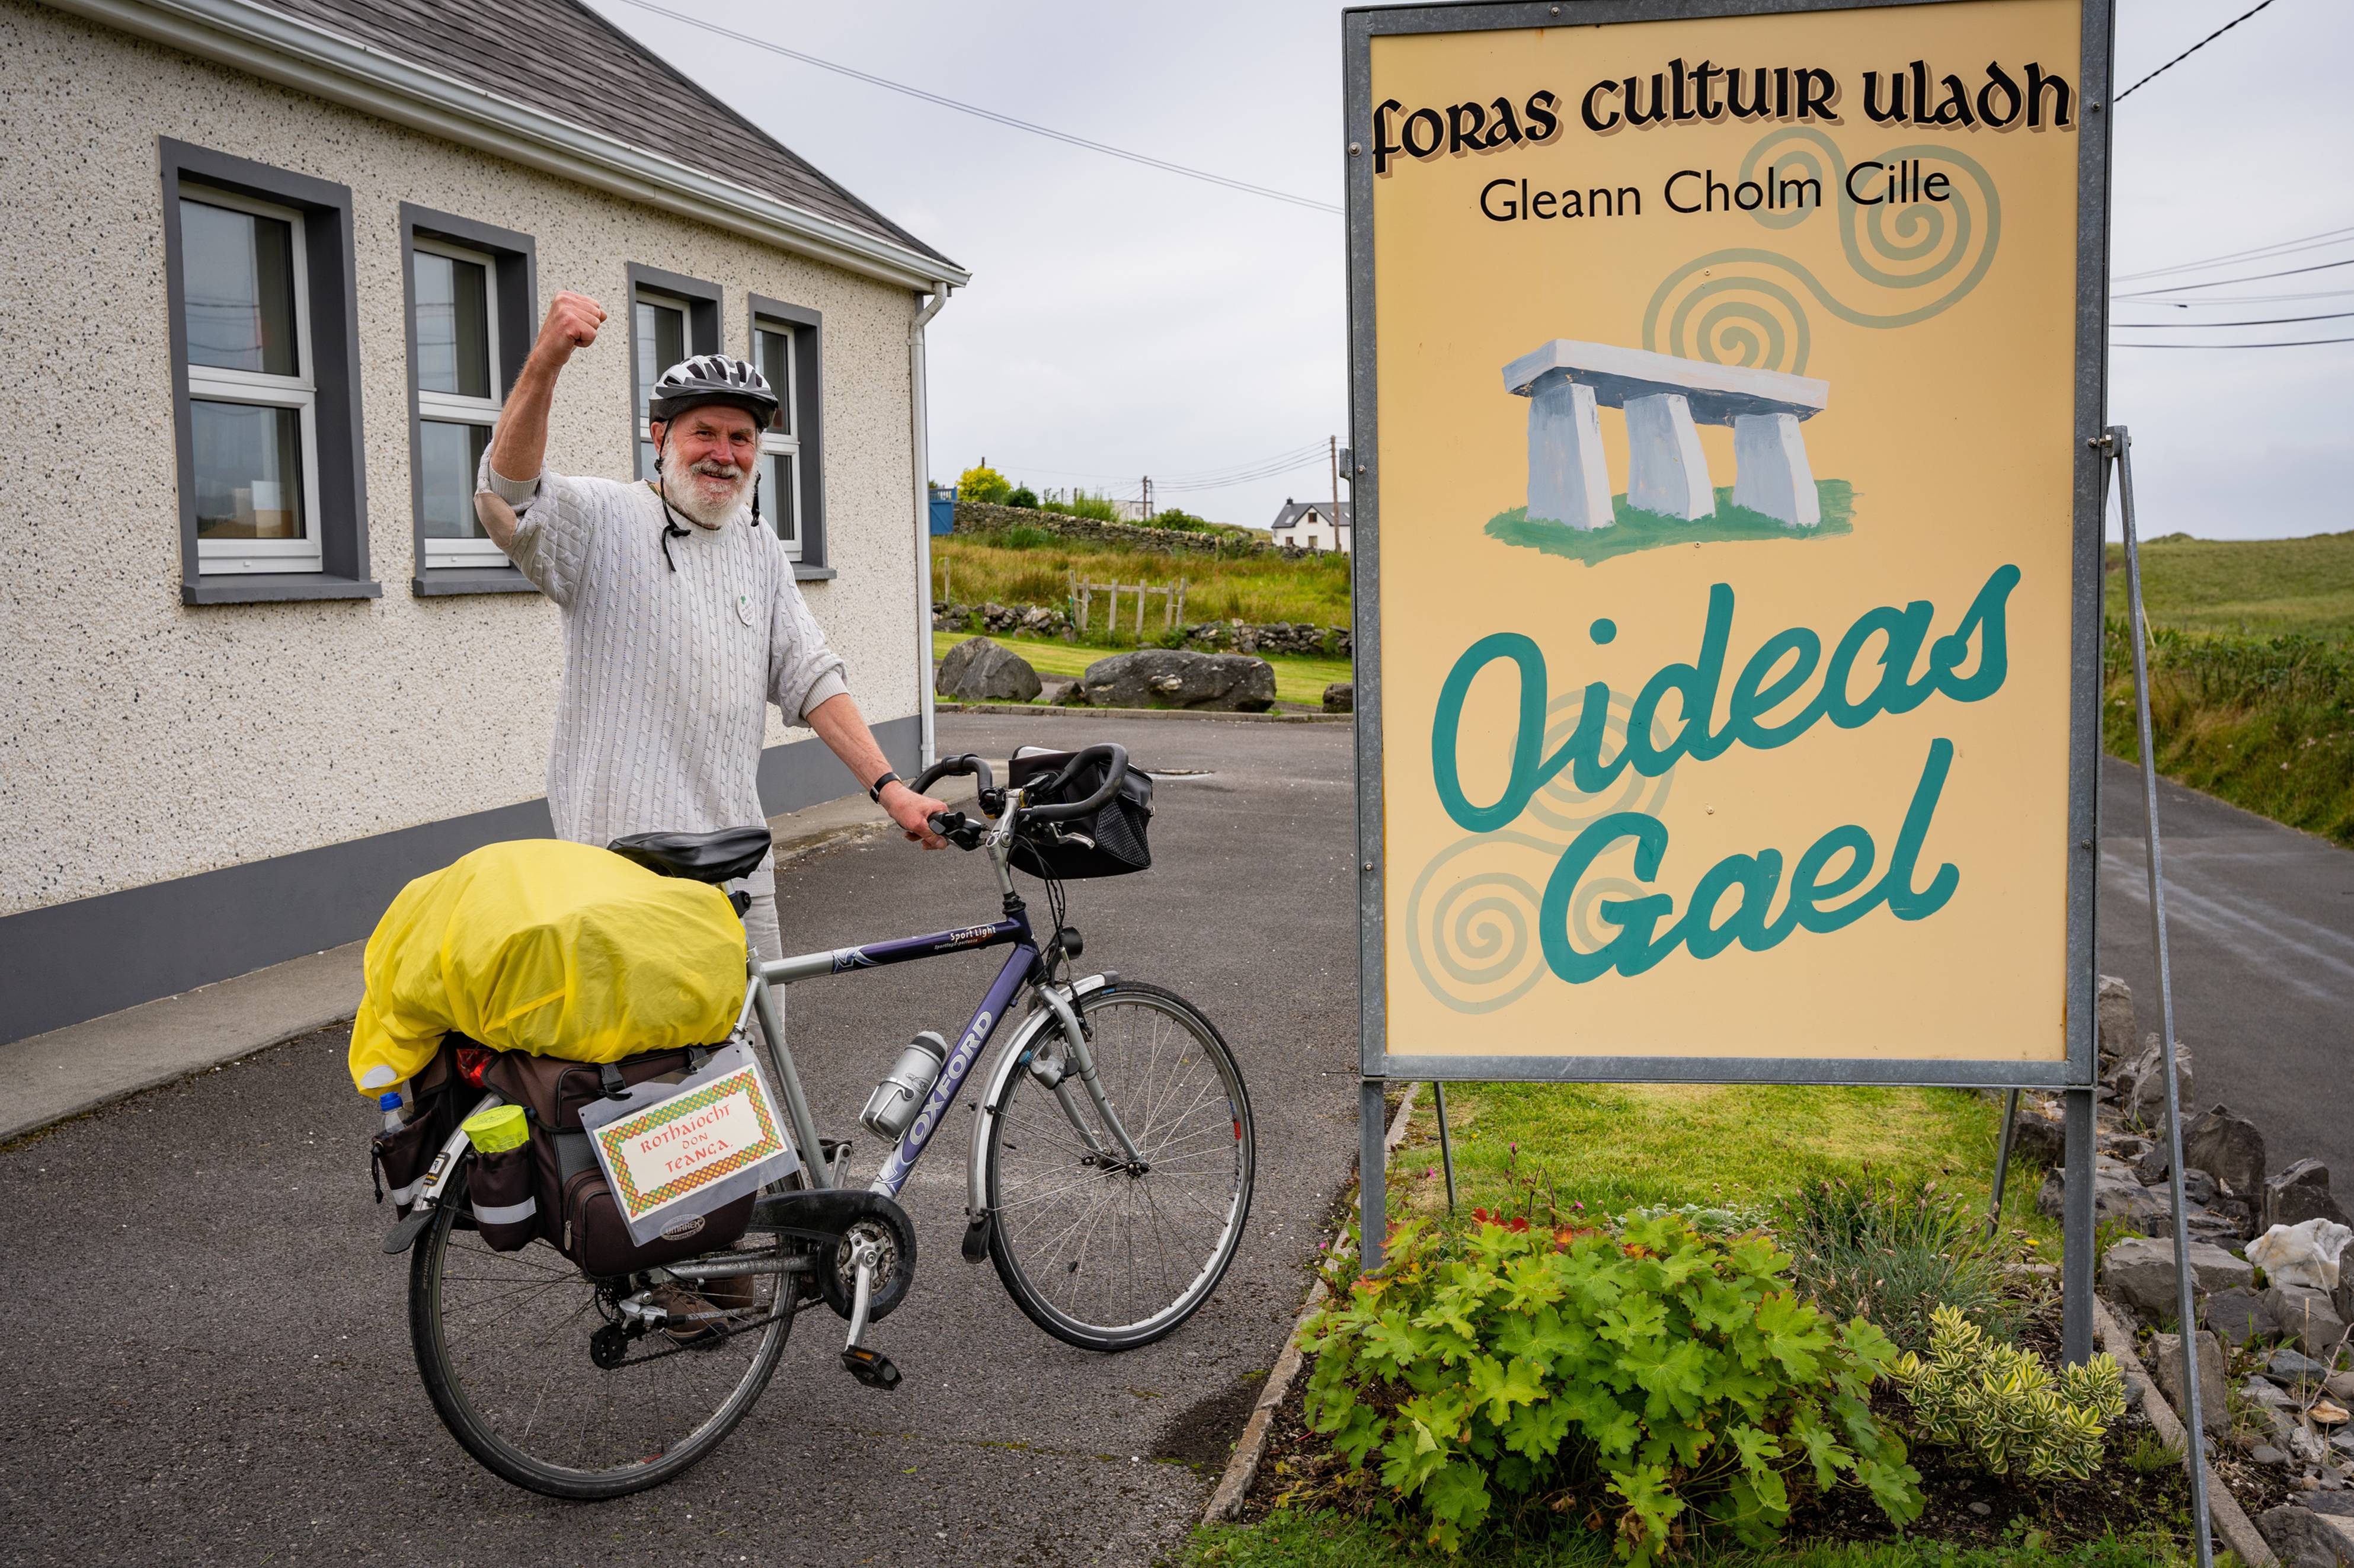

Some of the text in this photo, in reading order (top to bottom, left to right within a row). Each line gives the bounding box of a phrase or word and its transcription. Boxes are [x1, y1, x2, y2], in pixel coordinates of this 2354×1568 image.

[1480, 159, 1950, 222] Gleann Cholm Cille
[1432, 564, 2022, 833] Oideas
[1540, 738, 1959, 984] Gael
[950, 926, 996, 943] Sport Light
[910, 1011, 992, 1145] OXFORD
